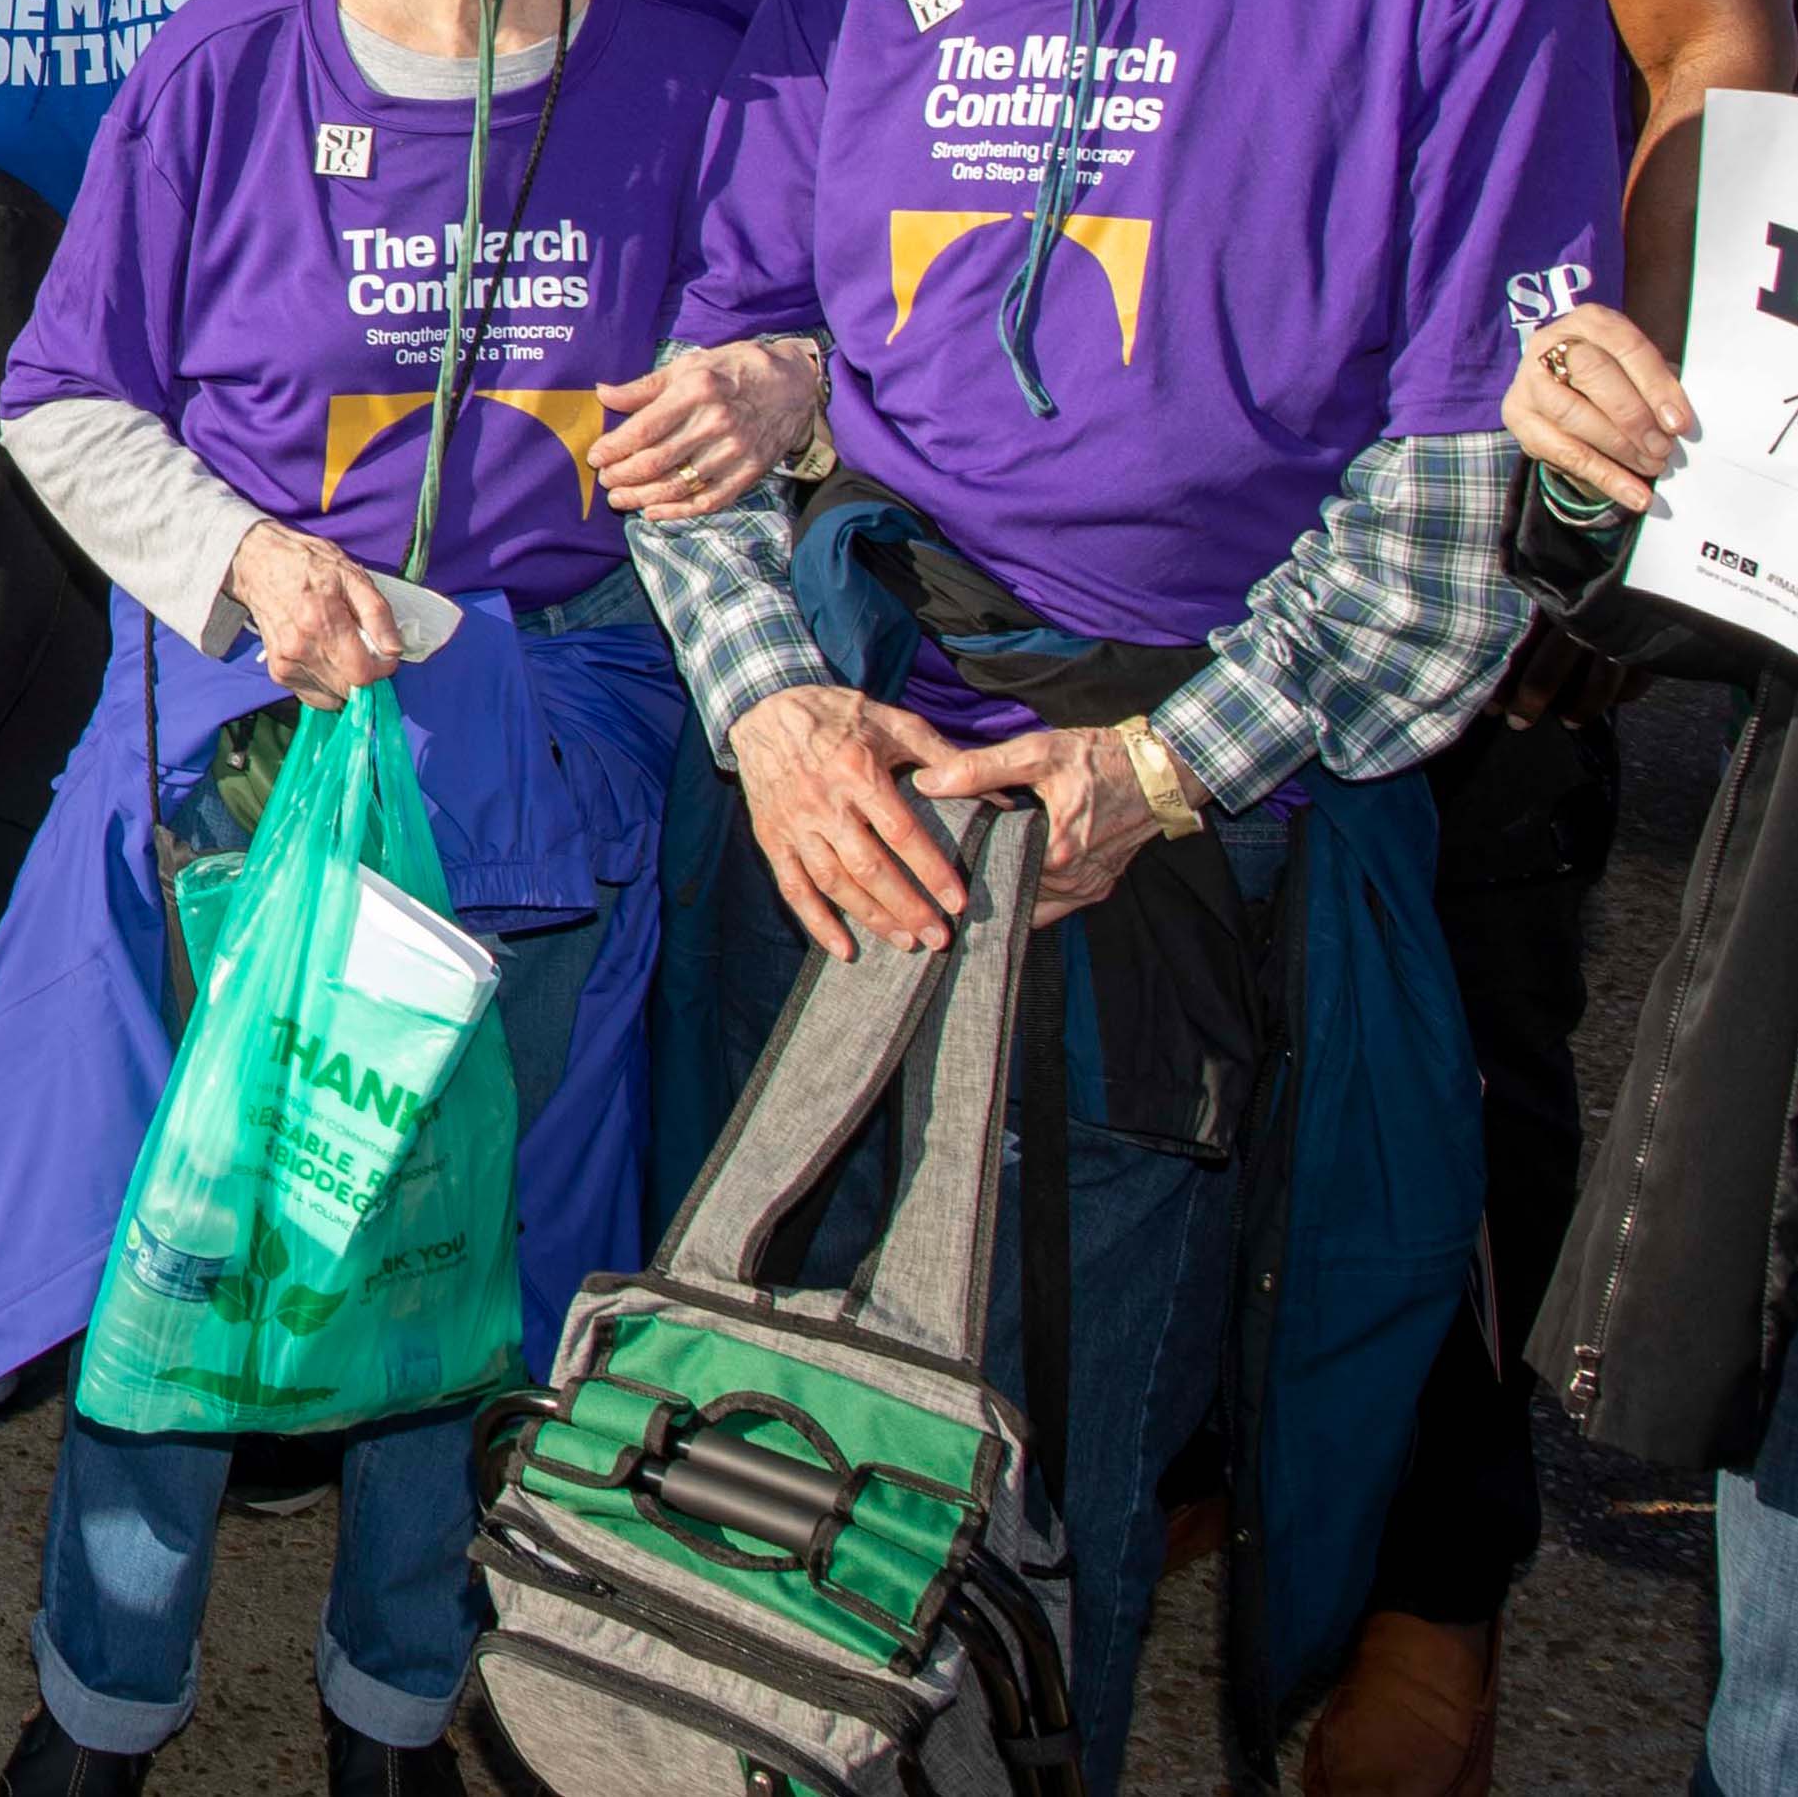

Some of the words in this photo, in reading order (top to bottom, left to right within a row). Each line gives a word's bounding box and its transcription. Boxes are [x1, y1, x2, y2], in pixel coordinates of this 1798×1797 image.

[935, 36, 1016, 82] The
[1018, 35, 1177, 83] March
[932, 140, 1040, 165] Strengthening
[952, 163, 982, 181] One
[985, 163, 1024, 186] Step
[343, 226, 438, 271] The
[443, 220, 589, 268] March
[395, 345, 426, 364] One
[502, 342, 544, 360] Time
